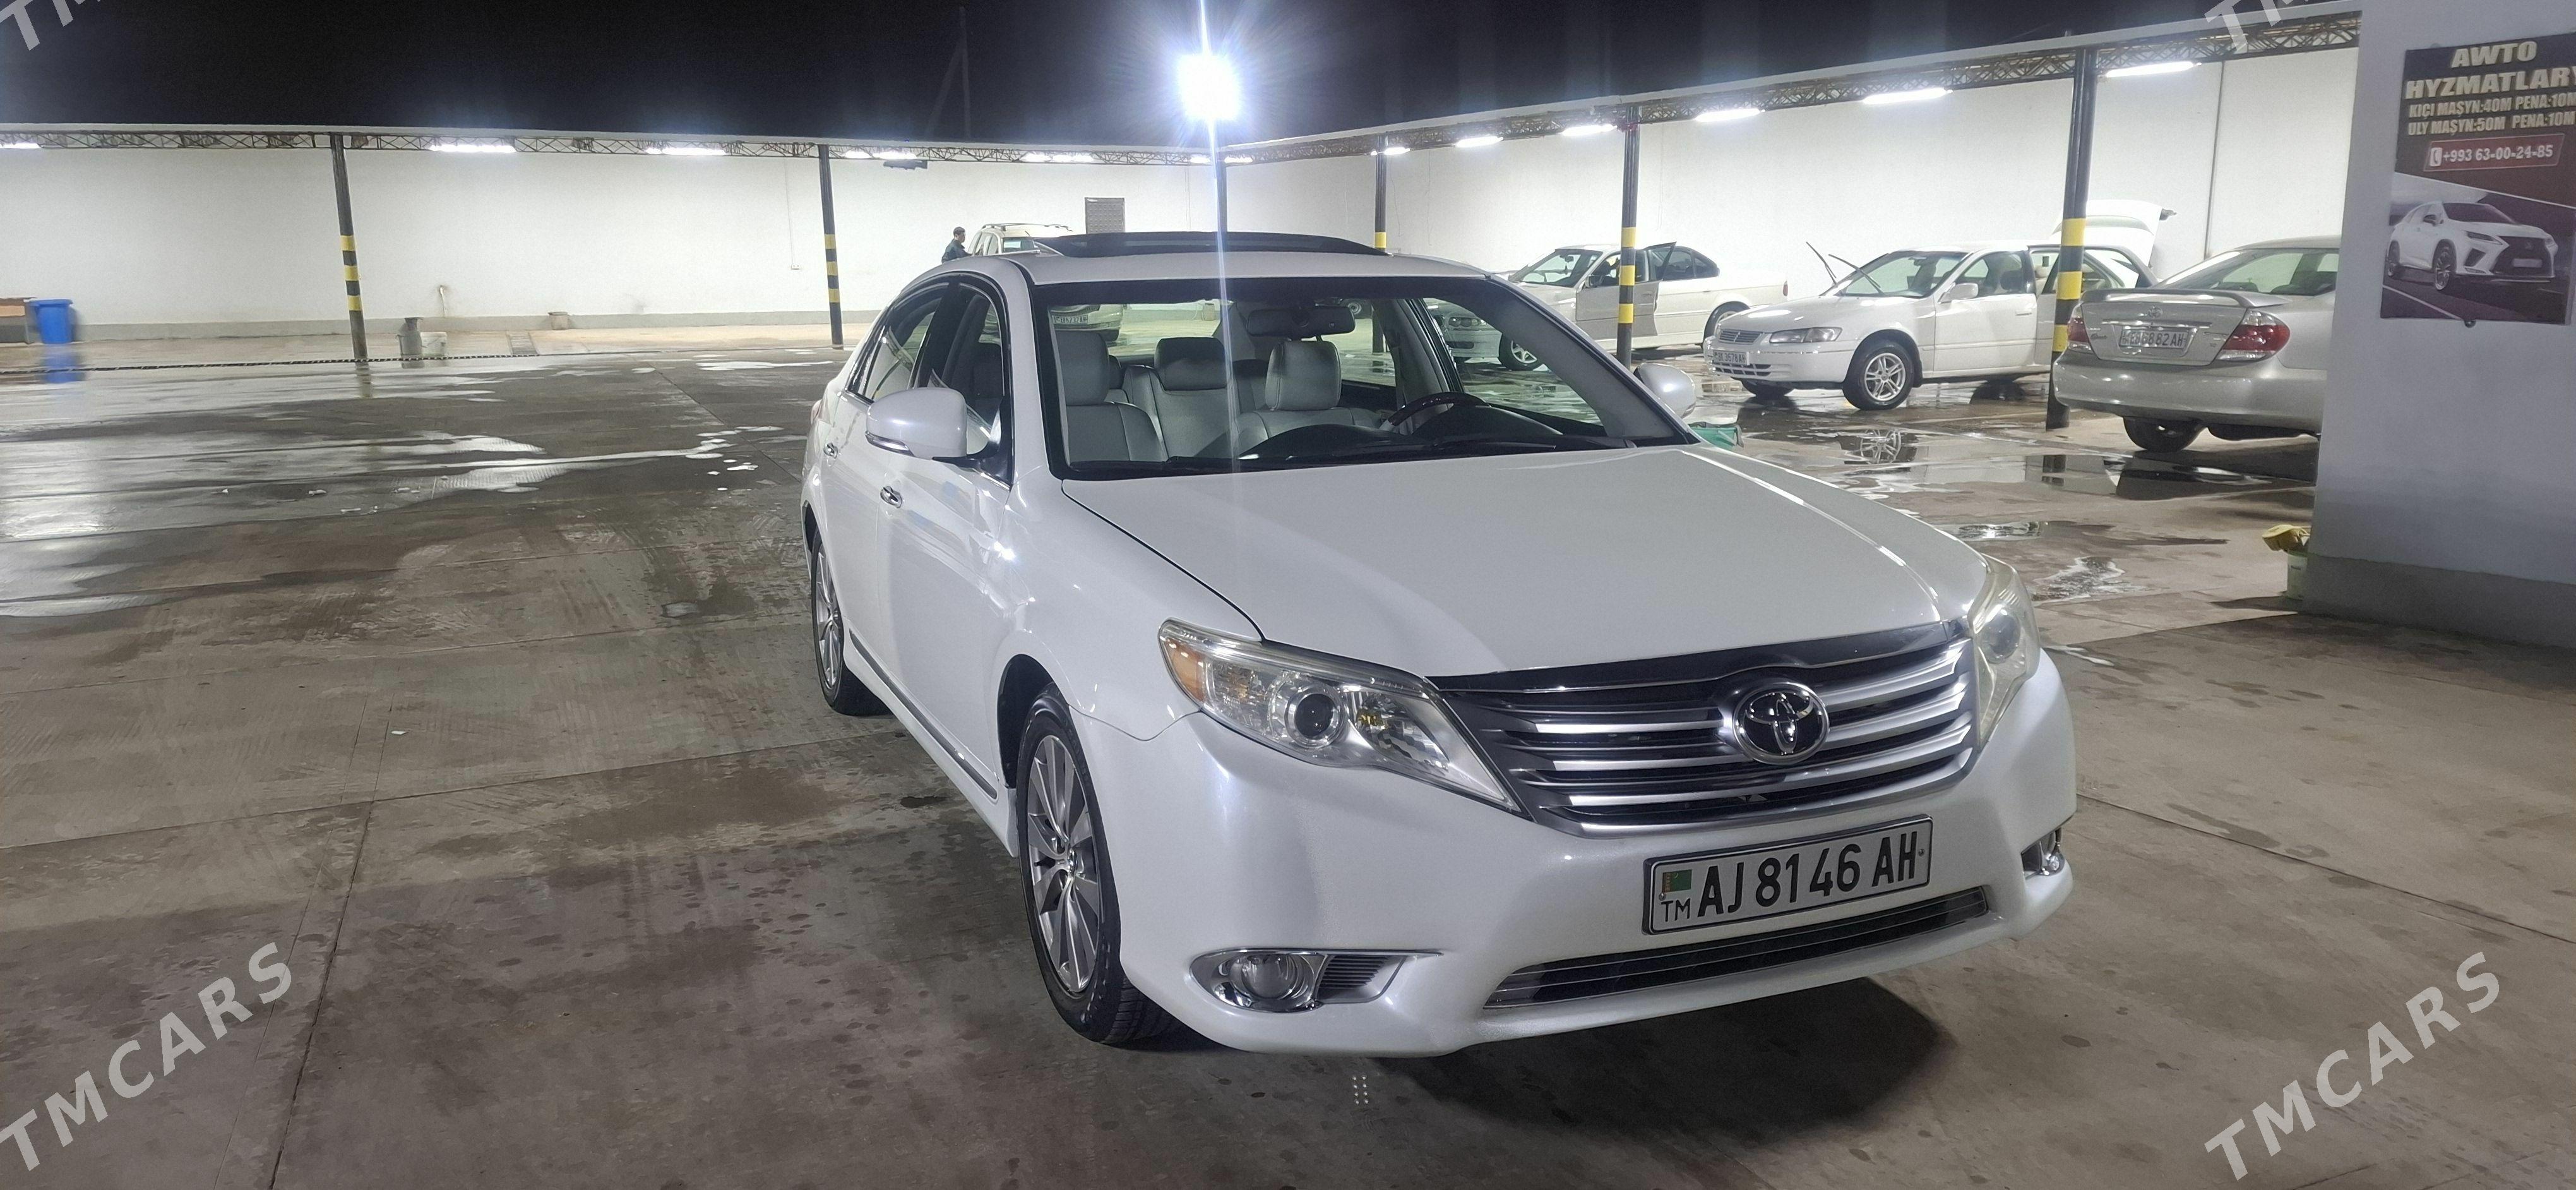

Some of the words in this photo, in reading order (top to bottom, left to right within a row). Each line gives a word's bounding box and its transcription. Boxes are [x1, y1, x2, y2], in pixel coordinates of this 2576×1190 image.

[2451, 41, 2537, 68] AWTO
[2408, 121, 2430, 136] ULY
[2443, 149, 2472, 162] +993
[2475, 144, 2554, 160] 63-00-24-85
[2170, 334, 2184, 346] AH
[1697, 862, 1744, 917] AJ
[1871, 831, 1917, 887] AH
[1661, 899, 1691, 922] TM
